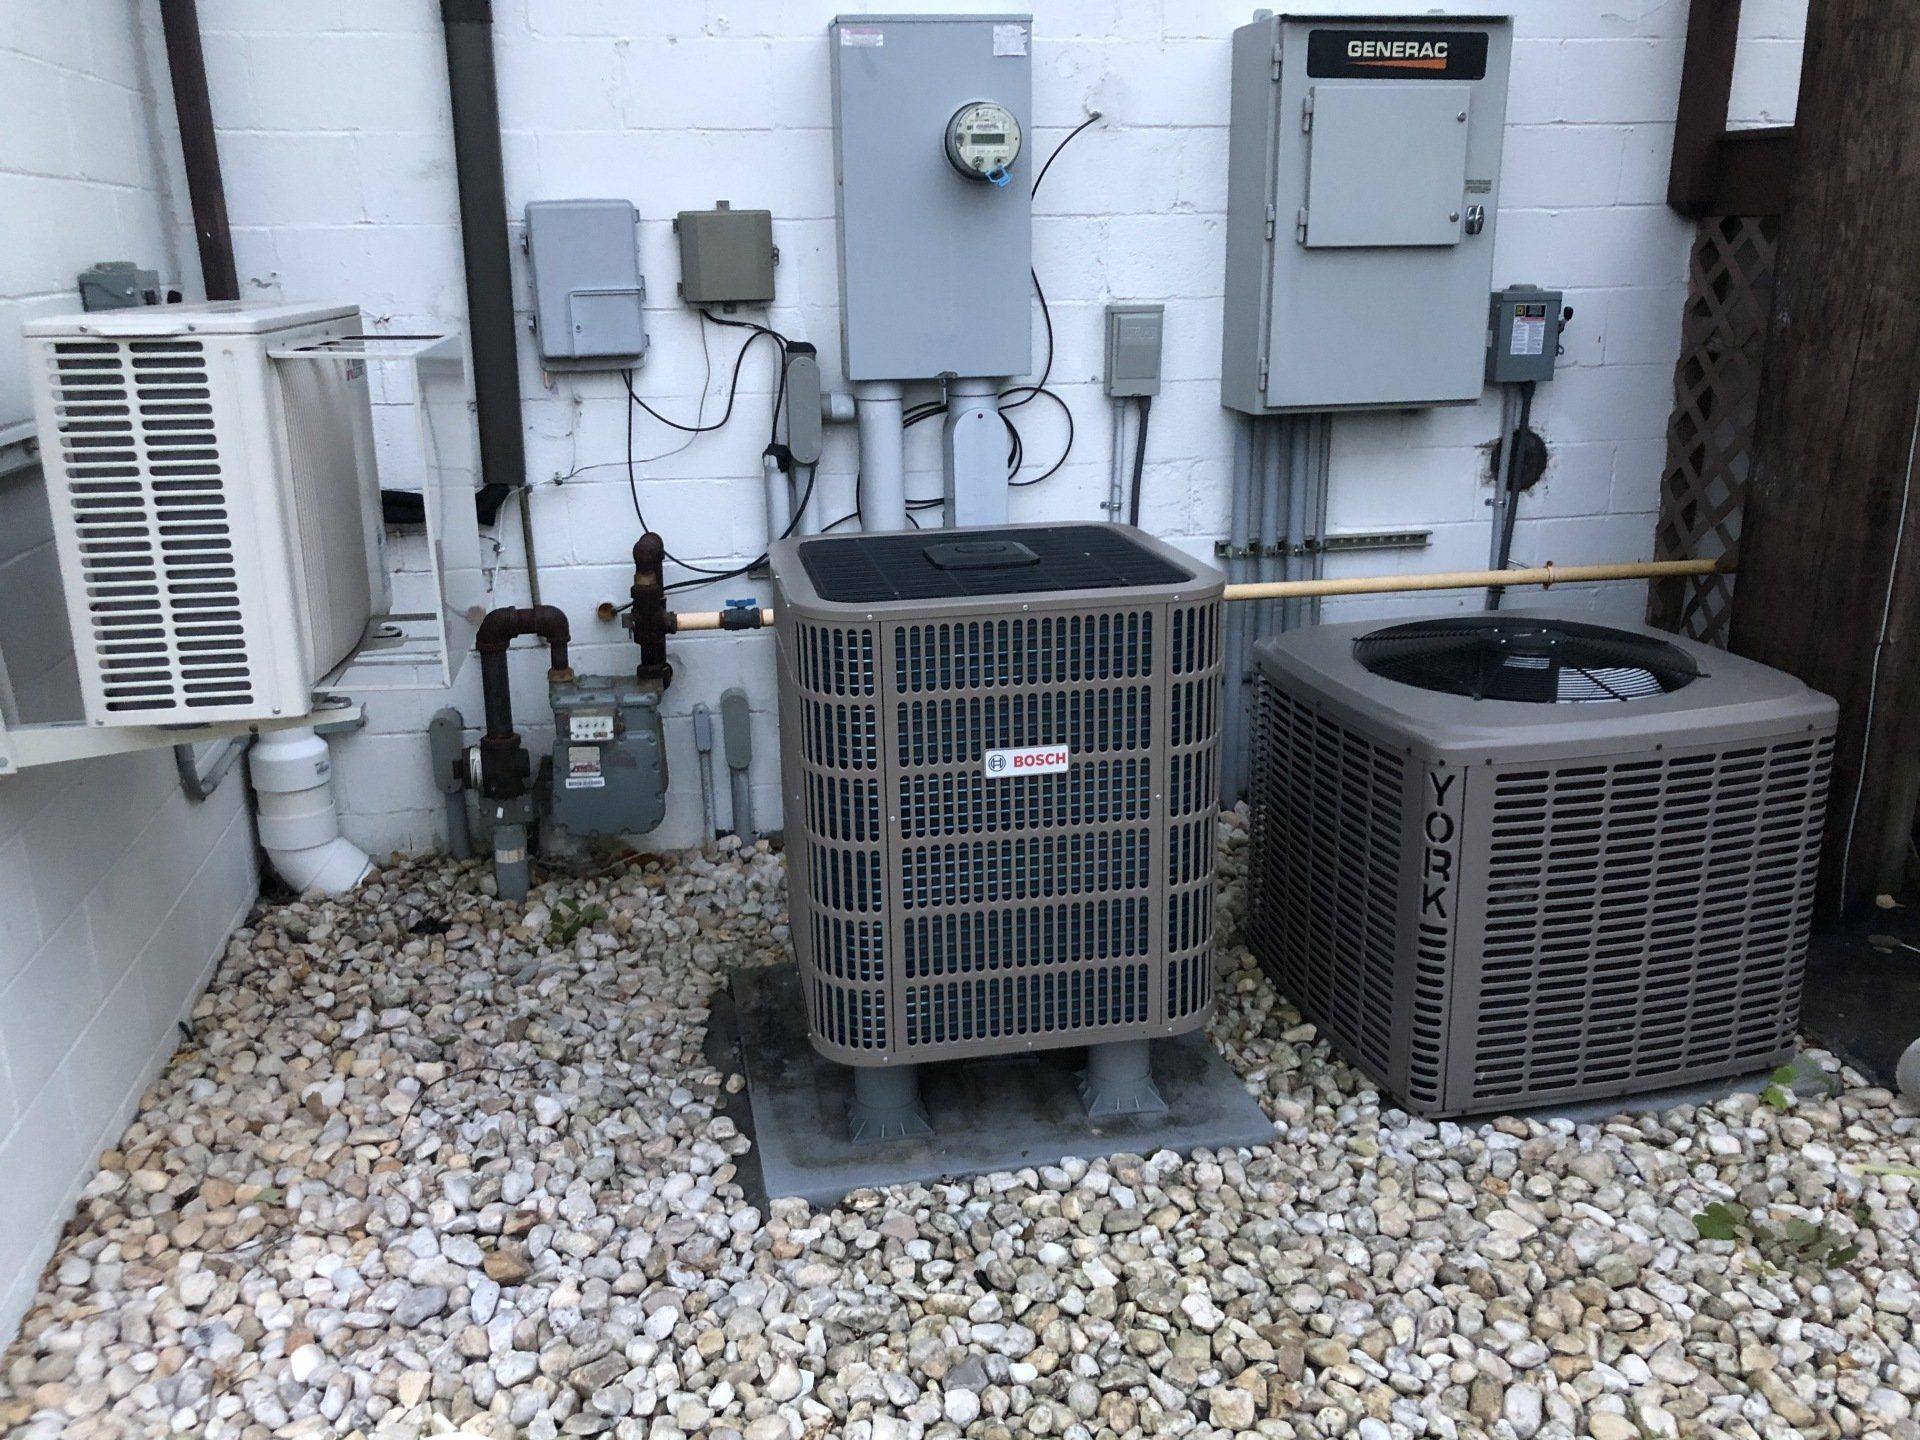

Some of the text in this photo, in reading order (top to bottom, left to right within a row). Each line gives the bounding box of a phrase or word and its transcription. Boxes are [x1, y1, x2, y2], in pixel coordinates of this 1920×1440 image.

[1347, 40, 1448, 58] GENERAC
[1013, 752, 1066, 768] BOSCH
[1421, 771, 1456, 919] YORK
